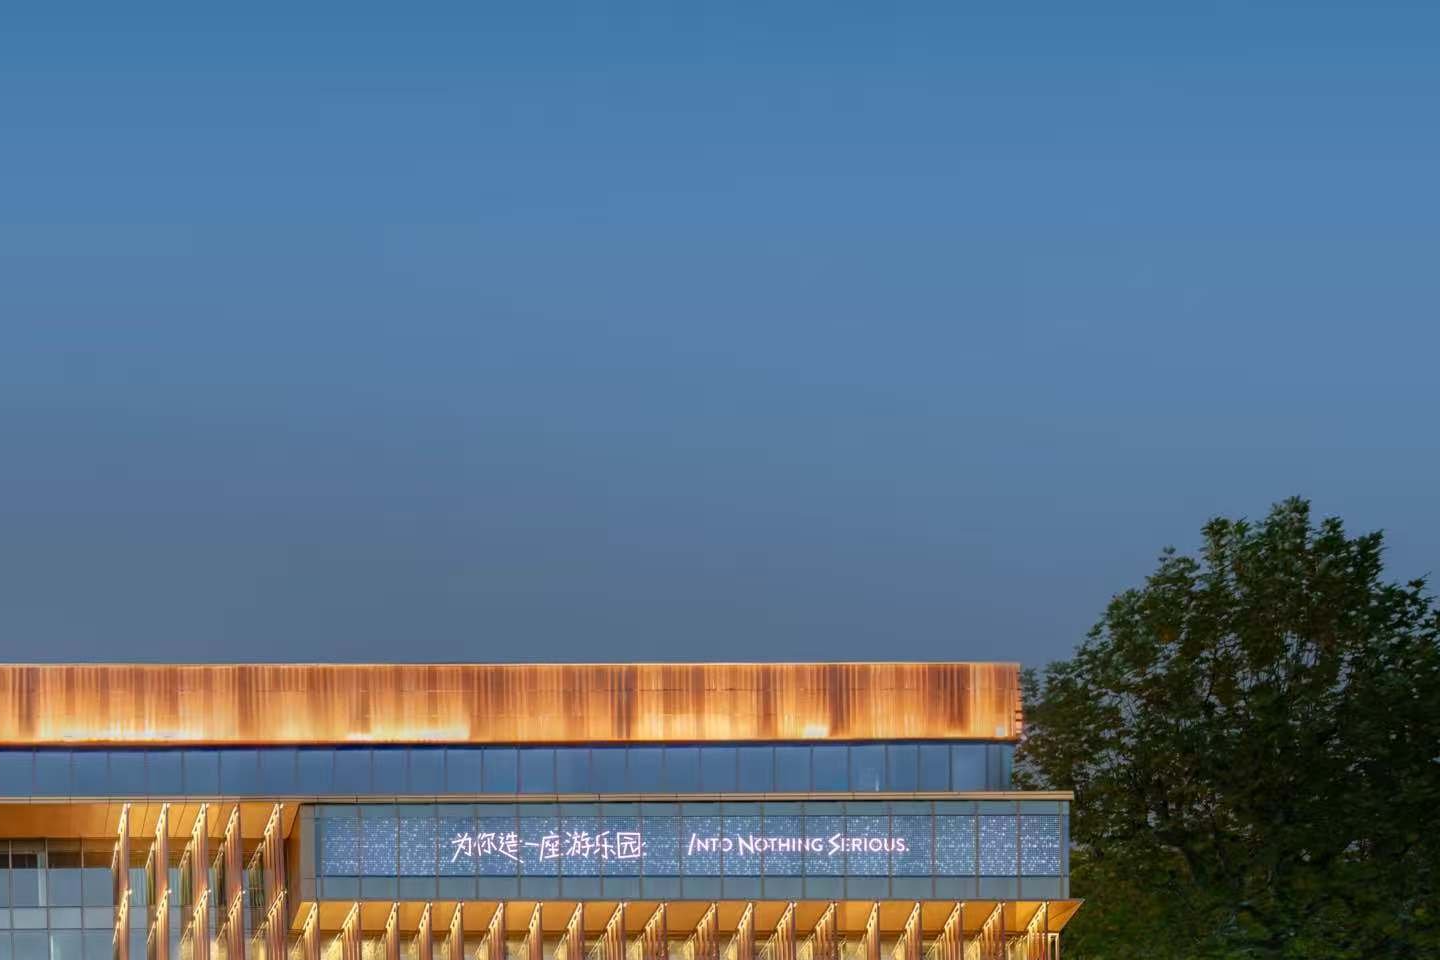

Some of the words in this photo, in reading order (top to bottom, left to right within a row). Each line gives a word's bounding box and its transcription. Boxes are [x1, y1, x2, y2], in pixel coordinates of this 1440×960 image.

[450, 831, 642, 863] 为你造一座游乐园
